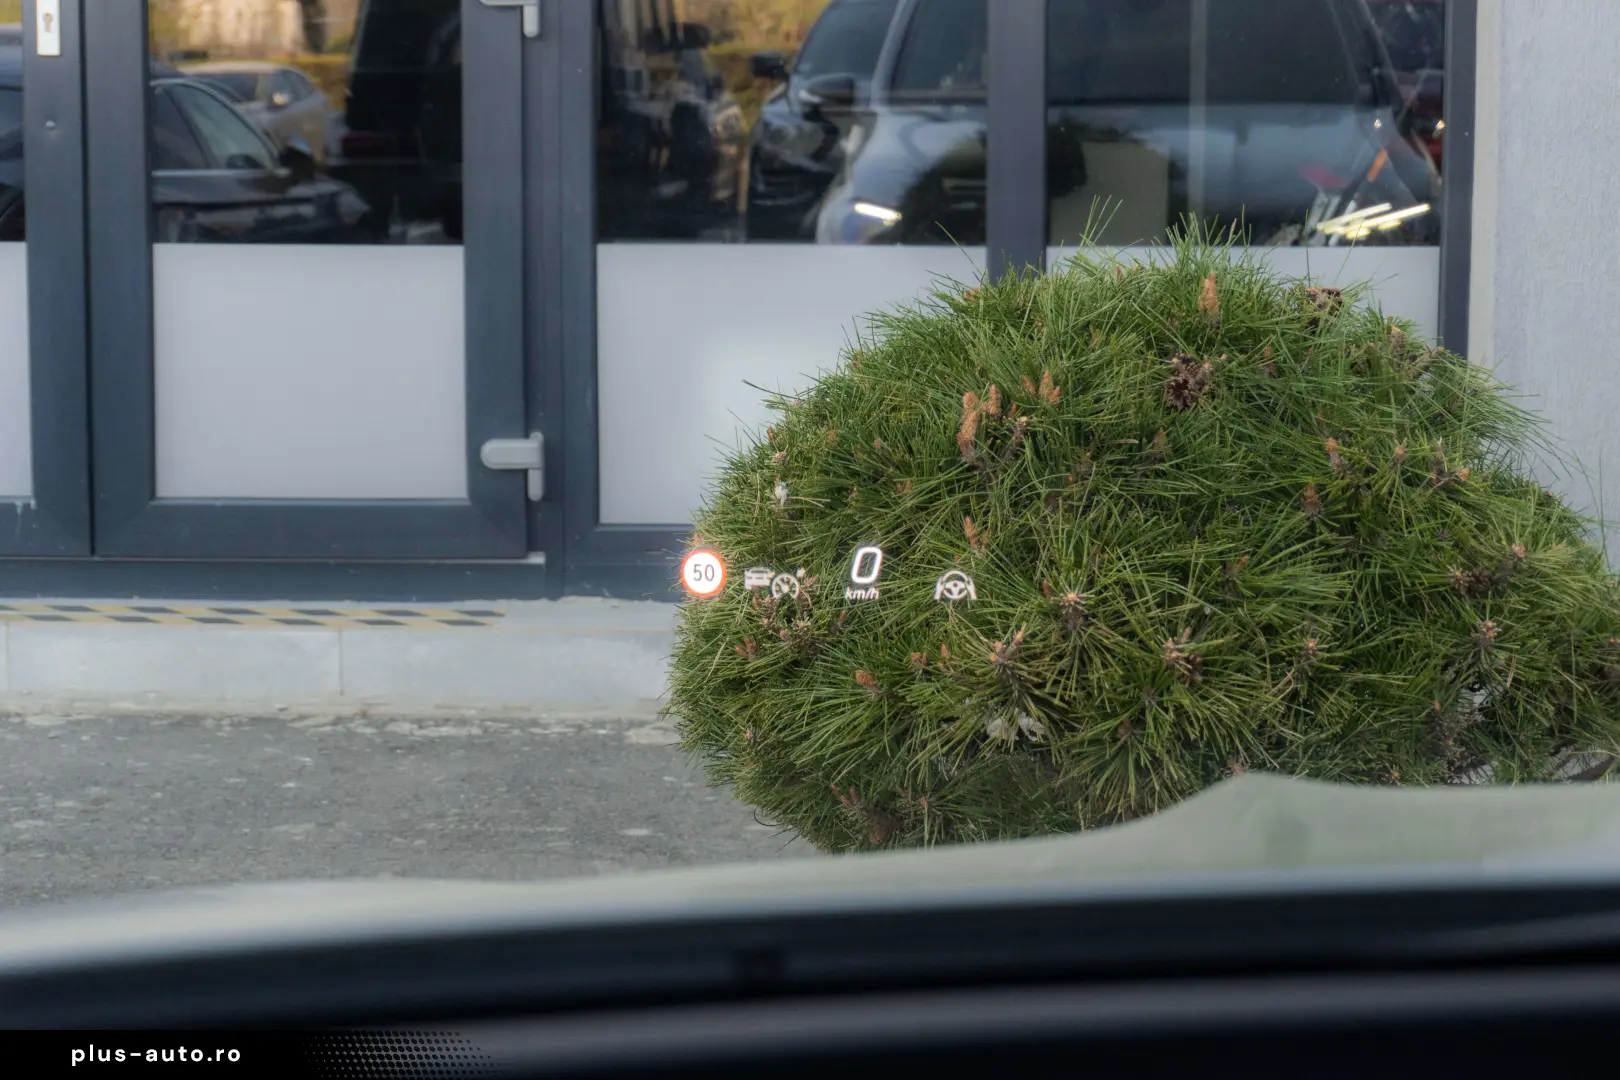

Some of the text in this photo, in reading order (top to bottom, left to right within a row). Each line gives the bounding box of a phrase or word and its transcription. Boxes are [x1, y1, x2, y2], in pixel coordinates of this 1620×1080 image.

[692, 563, 715, 582] 50
[851, 546, 882, 584] 0
[845, 587, 880, 600] km/h
